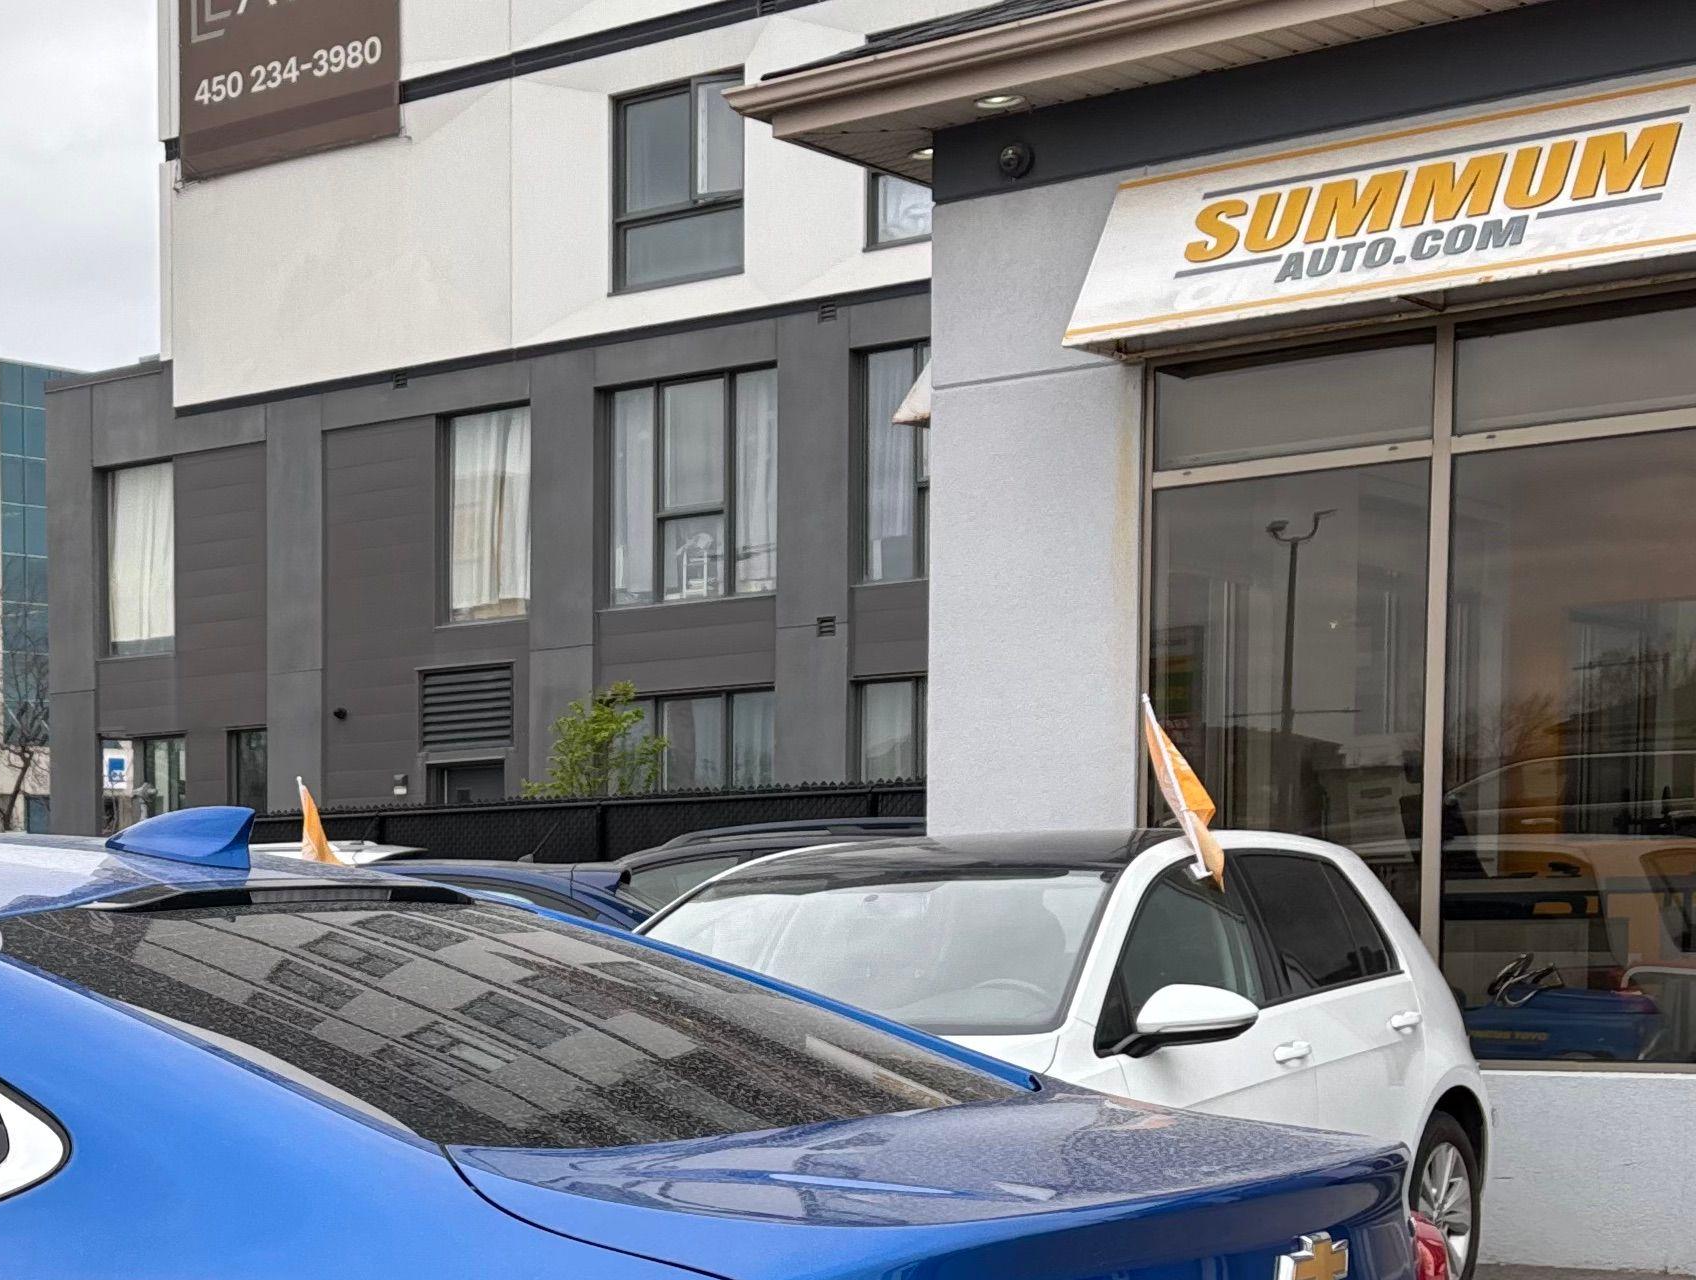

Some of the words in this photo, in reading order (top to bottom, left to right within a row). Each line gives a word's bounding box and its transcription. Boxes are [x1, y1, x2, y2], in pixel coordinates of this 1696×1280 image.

[194, 70, 244, 104] 450
[250, 36, 382, 94] 234-3980
[1182, 121, 1684, 264] SUMMUM
[1273, 214, 1528, 284] AUTO.COM
